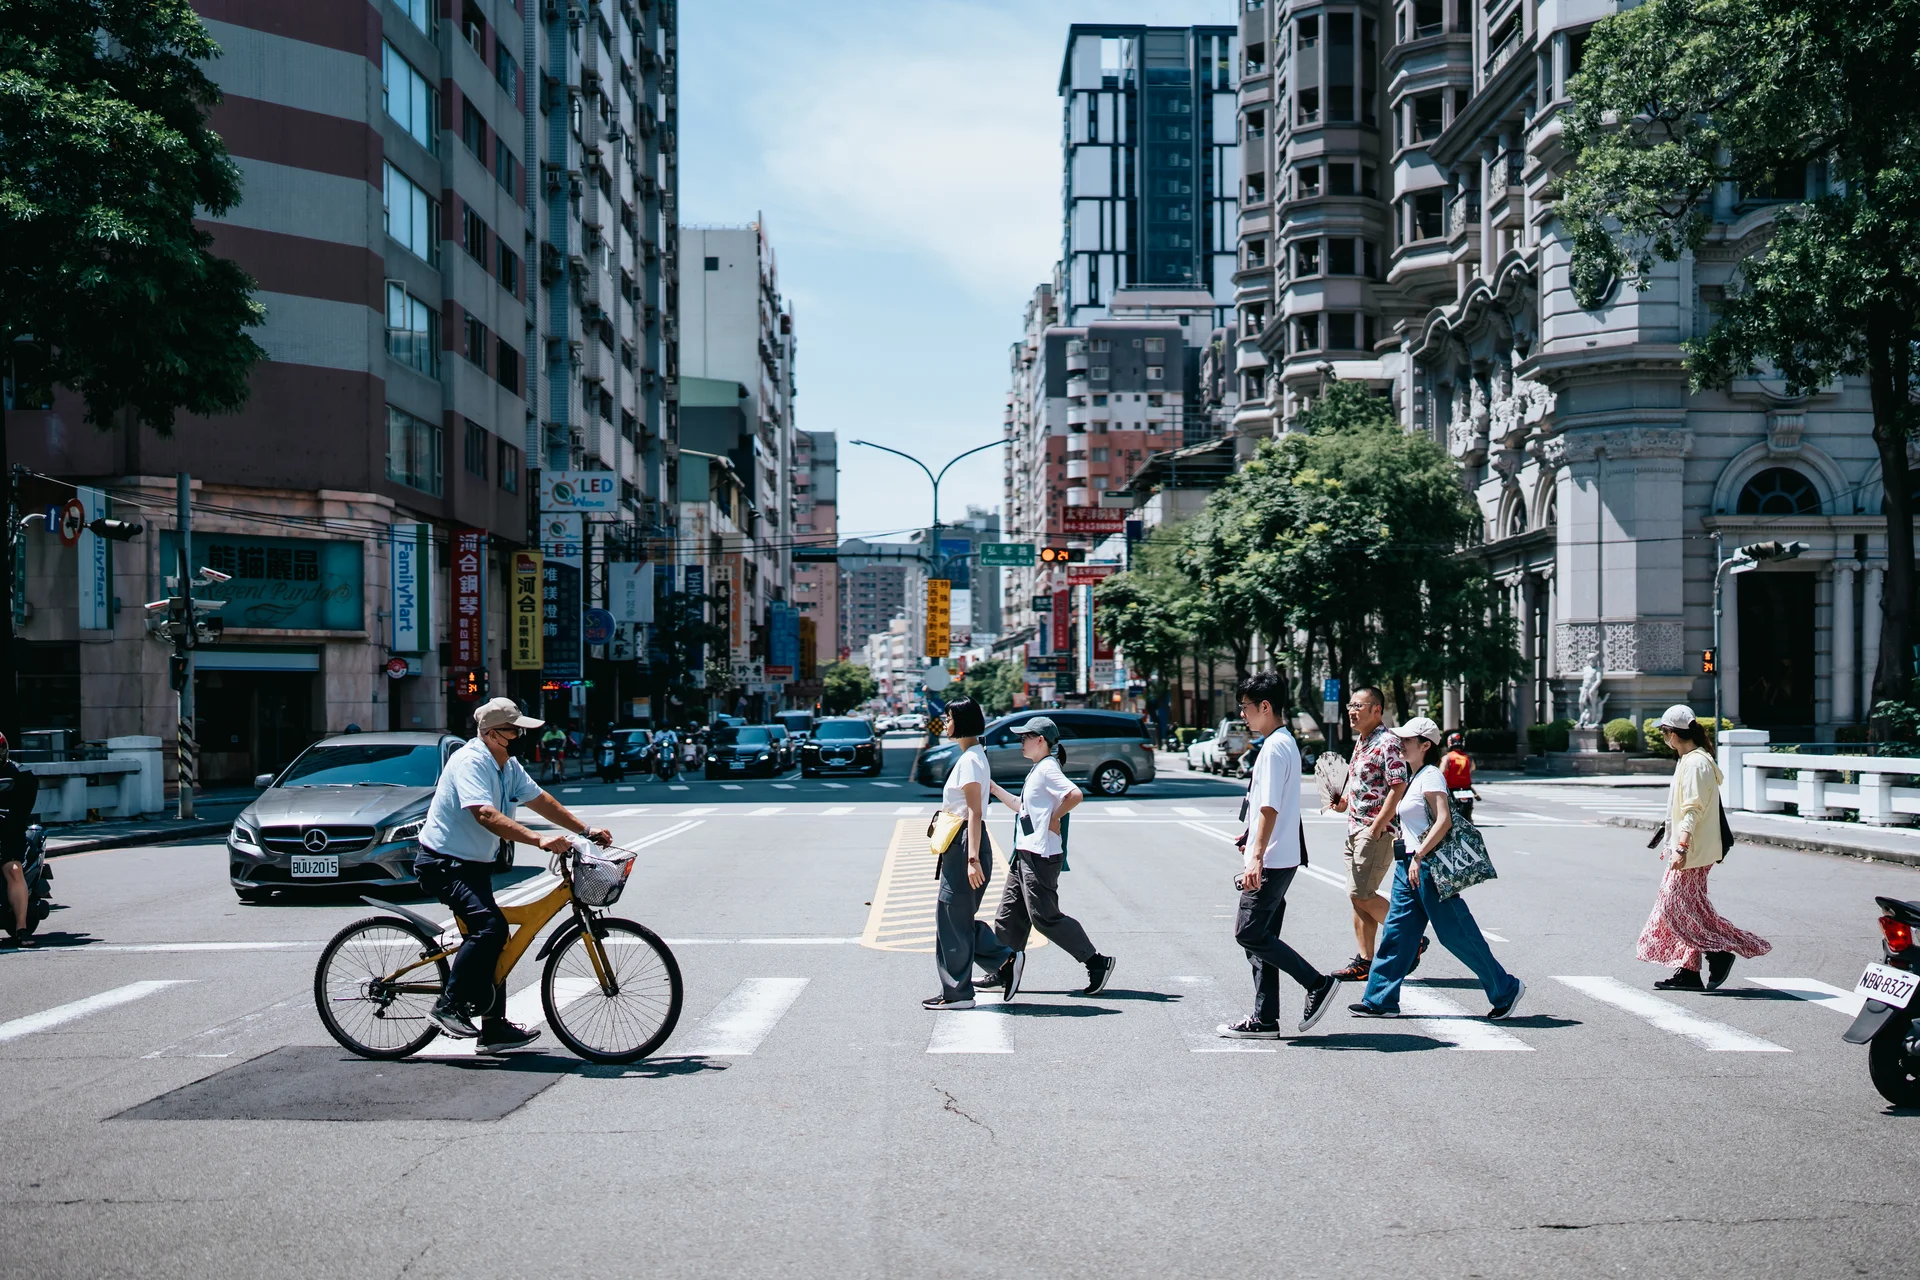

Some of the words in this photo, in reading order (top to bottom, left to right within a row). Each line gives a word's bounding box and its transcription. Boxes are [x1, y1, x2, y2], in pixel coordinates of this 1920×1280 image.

[581, 478, 613, 493] LED
[95, 507, 105, 608] FilyMart
[544, 543, 578, 558] LED
[397, 541, 414, 632] FamilyMart
[517, 576, 536, 613] 河合
[687, 571, 702, 622] YAAHA
[519, 615, 530, 660] 音樂教室
[1703, 662, 1713, 673] 34
[468, 683, 478, 694] 34
[1454, 758, 1467, 775] 7
[292, 861, 338, 874] BUU-2015
[1859, 971, 1914, 999] NBQ-8327
